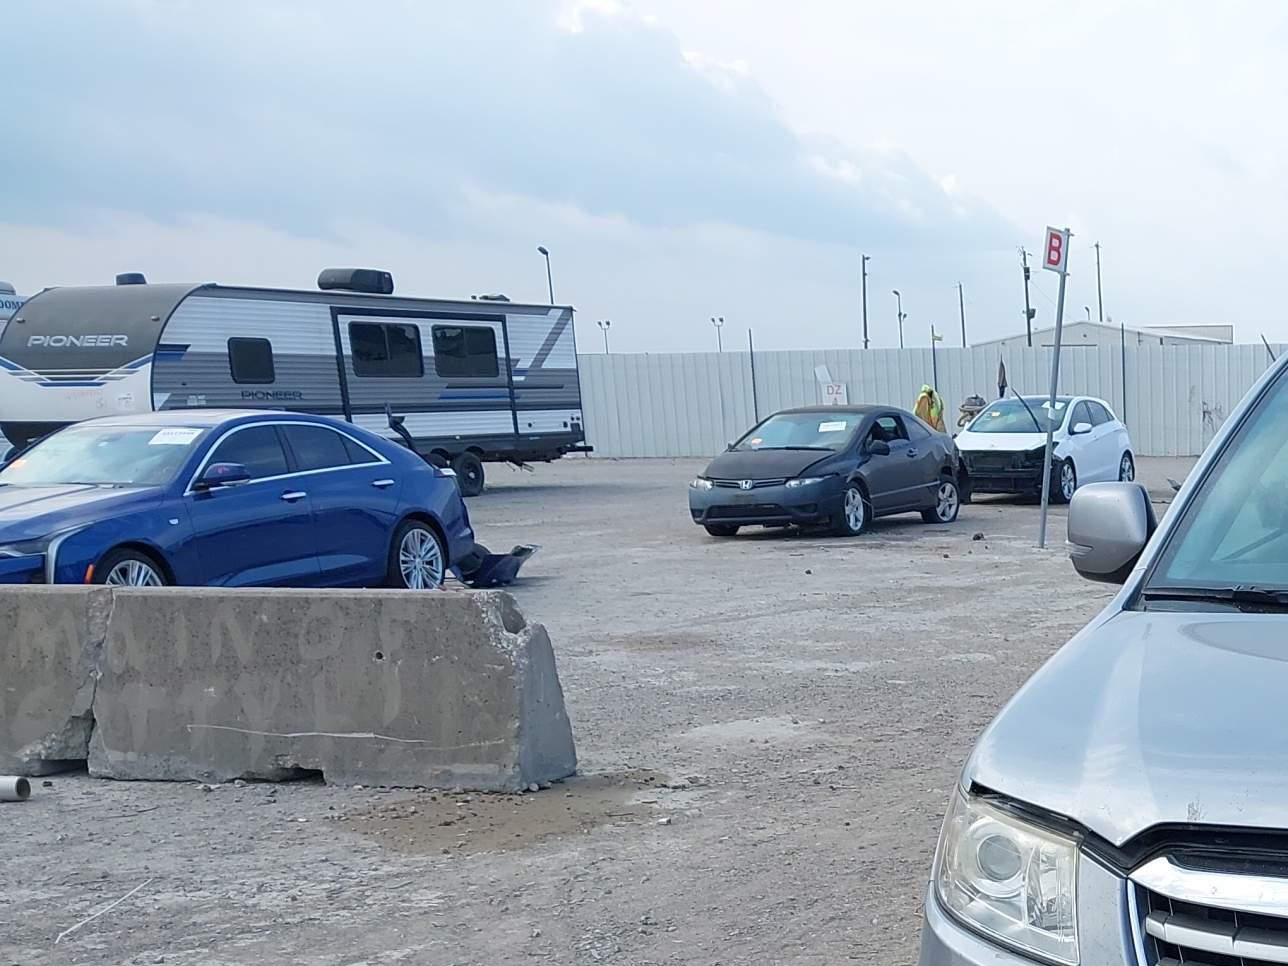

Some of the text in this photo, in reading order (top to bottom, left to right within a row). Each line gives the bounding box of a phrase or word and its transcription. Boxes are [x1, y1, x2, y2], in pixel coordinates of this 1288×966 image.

[1047, 231, 1063, 266] B
[27, 335, 128, 347] PIONEER
[240, 391, 303, 401] PIONEER
